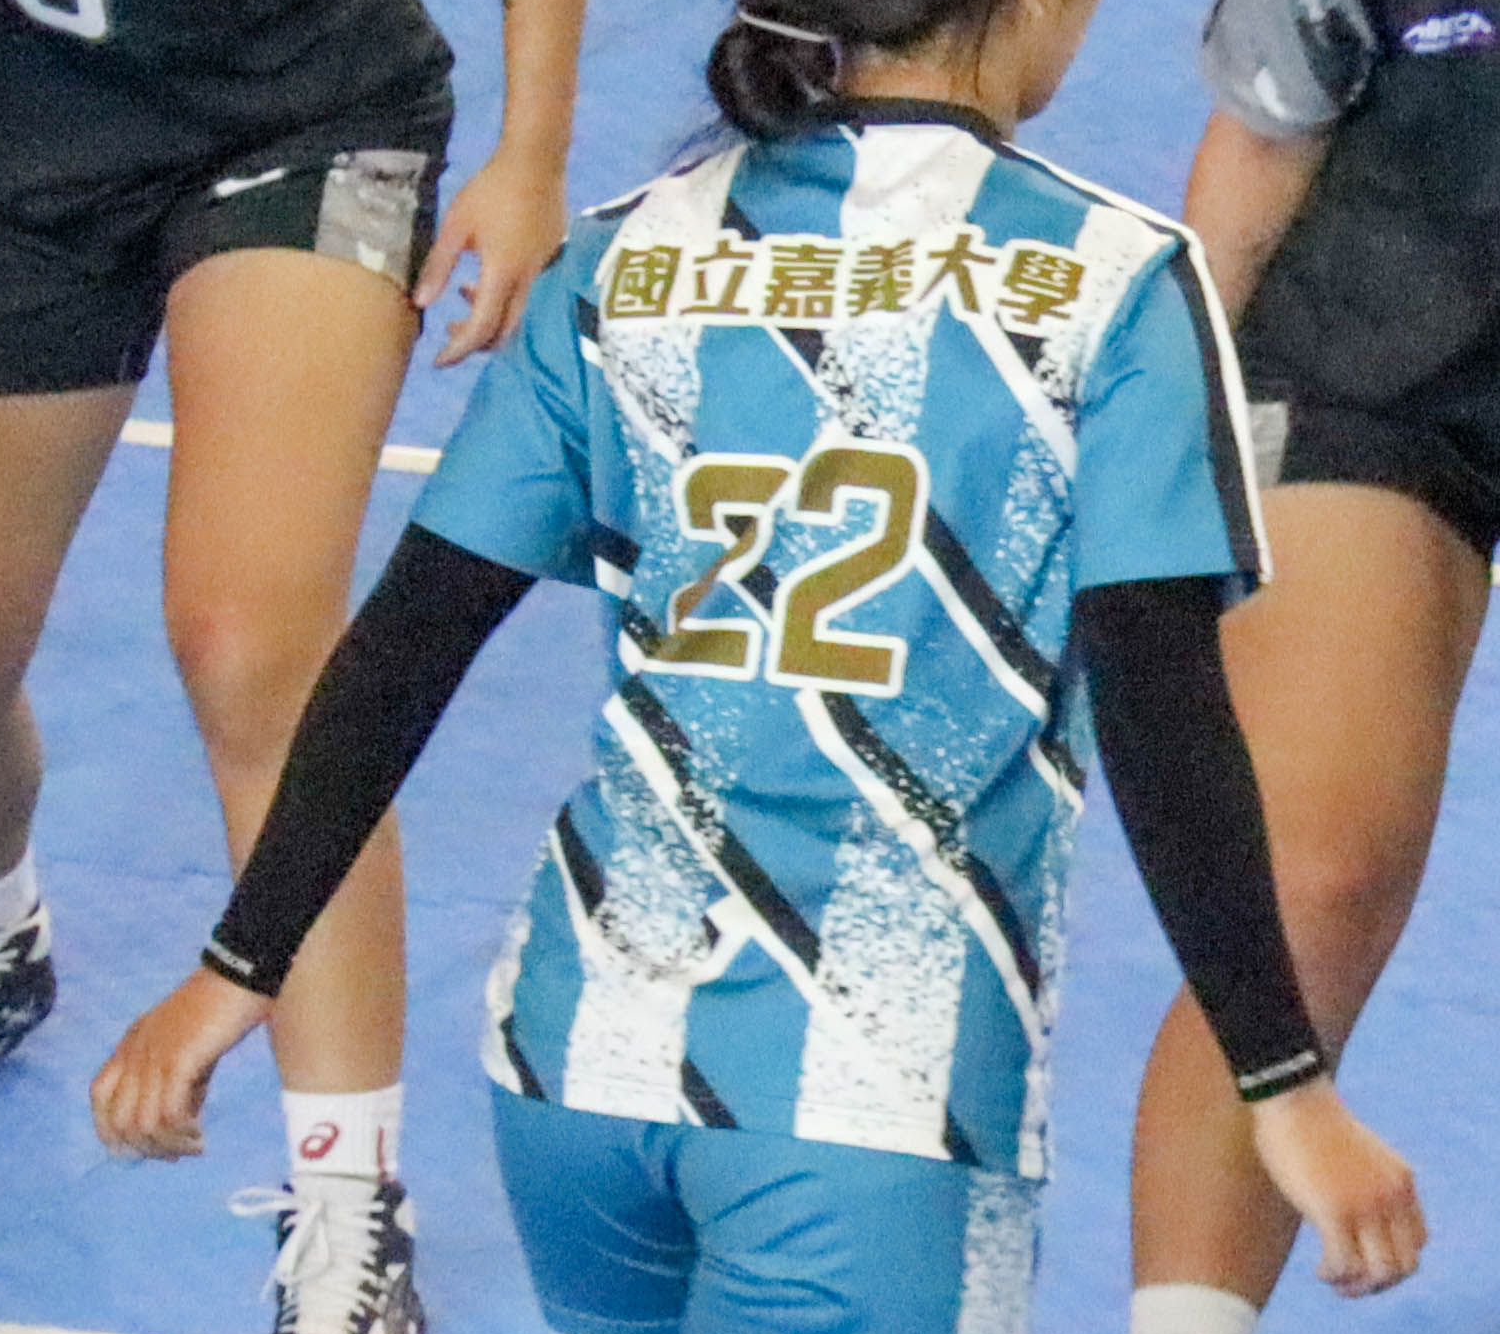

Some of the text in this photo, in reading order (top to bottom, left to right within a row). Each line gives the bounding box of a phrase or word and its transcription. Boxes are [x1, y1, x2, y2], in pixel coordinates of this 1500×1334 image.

[600, 231, 1090, 327] 國立嘉義大學
[656, 447, 926, 693] 22
